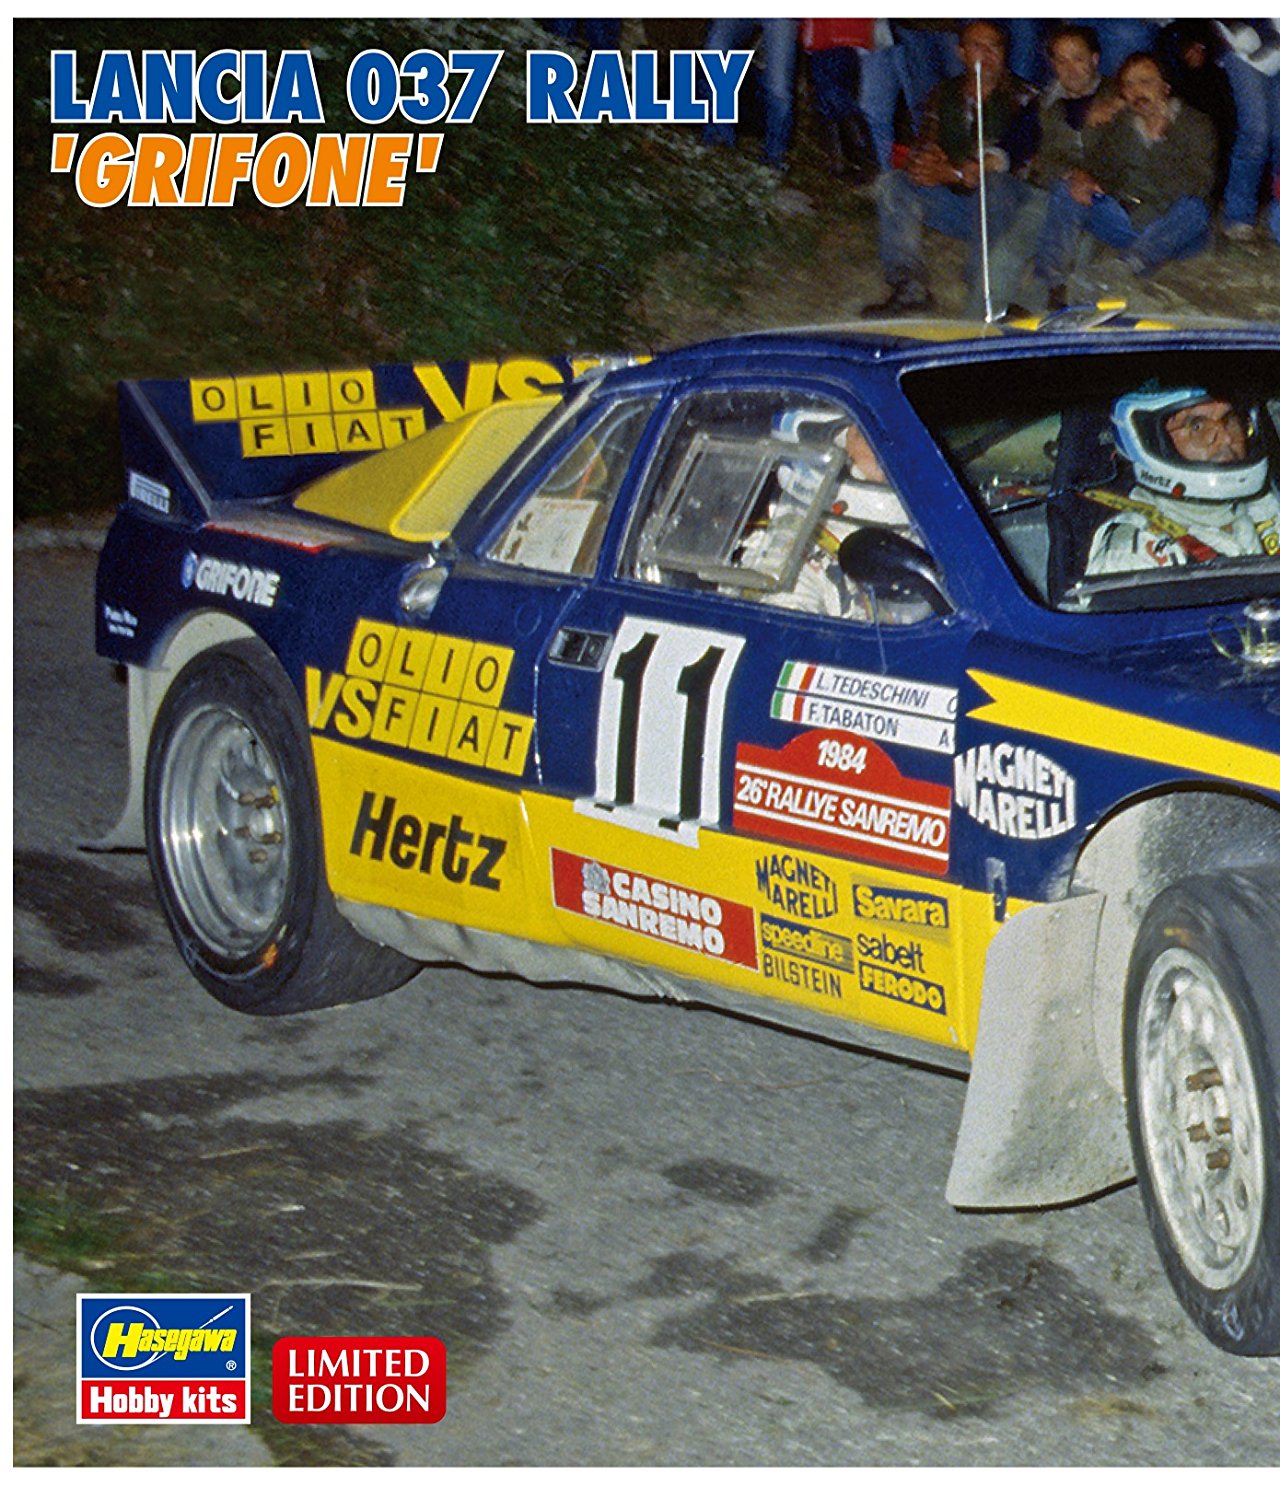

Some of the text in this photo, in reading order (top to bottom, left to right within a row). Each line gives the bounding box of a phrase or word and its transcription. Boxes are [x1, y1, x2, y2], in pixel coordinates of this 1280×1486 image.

[200, 377, 367, 413] OLIO
[252, 414, 416, 451] FIAT
[1139, 468, 1173, 488] Hertz
[195, 557, 282, 608] GRIFONE
[358, 631, 500, 694] OLIO
[305, 666, 524, 762] VS FIAT
[594, 631, 728, 832] 11
[816, 739, 869, 775] 1984
[954, 742, 1076, 802] MAGNETI
[764, 780, 840, 823] RALLYE
[837, 797, 947, 848] SANREMO
[954, 784, 1077, 839] MARELLI
[349, 790, 509, 892] Hertz
[755, 854, 840, 894] MAGNETI
[581, 889, 726, 956] SANREMO
[612, 871, 723, 927] CASINO
[756, 880, 840, 920] MARELLI
[855, 884, 947, 928] Savara
[762, 952, 843, 999] BILSTEIN
[857, 932, 926, 974] sabelt
[861, 964, 943, 1010] FERODO
